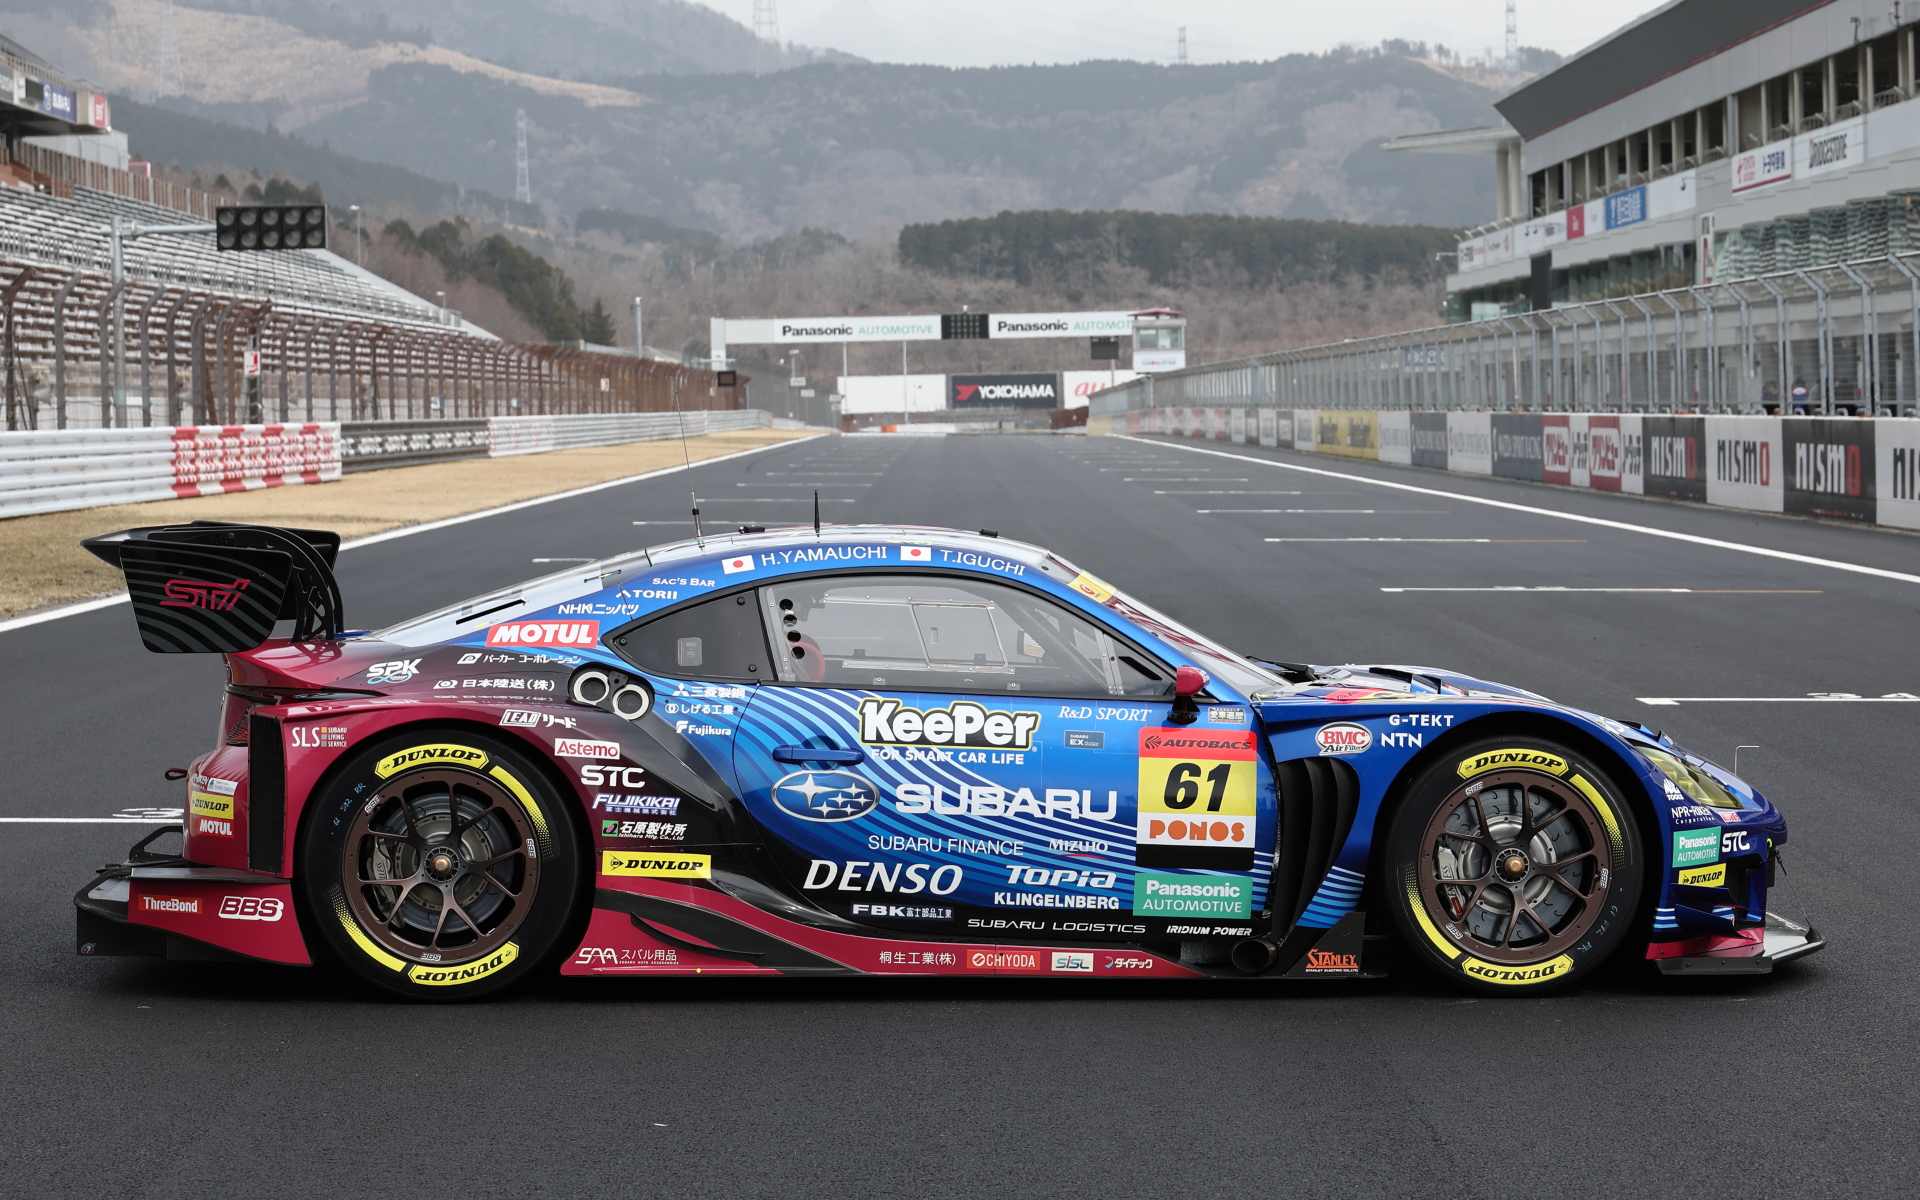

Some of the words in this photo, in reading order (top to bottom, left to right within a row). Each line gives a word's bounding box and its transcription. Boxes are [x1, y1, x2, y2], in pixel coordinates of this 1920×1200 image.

[1809, 134, 1847, 168] BRIDGESTONE
[782, 324, 852, 336] Panasonic
[858, 325, 933, 335] AUTOMOTIVE
[998, 320, 1068, 332] Panasonic
[1074, 320, 1132, 330] AUTOMOT
[978, 384, 1054, 399] YOKOHAMA
[1651, 436, 1696, 478] nismo
[1718, 440, 1770, 486] nismo
[1796, 442, 1860, 496] nismo
[1893, 448, 1920, 499] ni
[761, 546, 887, 566] H.YAMAUCHI
[940, 550, 1026, 576] T.IGUCHI
[632, 590, 678, 599] TORII
[492, 624, 593, 644] MOTUL
[366, 658, 422, 678] SPK
[680, 704, 734, 716] しげる工業
[1059, 706, 1092, 720] R&D
[1096, 708, 1152, 722] SPORT
[542, 714, 577, 728] リード
[862, 702, 1036, 746] KeePer
[1388, 714, 1454, 726] G-TEKT
[292, 727, 320, 748] SLS
[688, 725, 732, 736] Fujikura
[1323, 731, 1366, 746] BMC
[1162, 738, 1252, 750] AUTOBACS
[1381, 732, 1422, 748] NTN
[556, 740, 618, 758] Astemo
[871, 748, 900, 761] FOR
[905, 749, 956, 762] SMART
[958, 751, 986, 764] CAR
[992, 752, 1024, 765] LIFE
[1323, 744, 1343, 753] Air
[392, 748, 482, 768] DUNLOP
[1474, 752, 1562, 770] DUNLOP
[580, 764, 646, 788] STC
[1163, 762, 1232, 812] 61
[194, 798, 229, 811] DUNLOP
[592, 794, 680, 809] FUJIKIKAI
[895, 784, 1117, 820] SUBARU
[1671, 805, 1712, 818] NPR-RIKEN
[200, 819, 232, 836] MOTUL
[620, 821, 688, 836] 石原製作所
[1150, 820, 1244, 842] PONOS
[868, 835, 942, 853] SUBARU
[948, 838, 1024, 856] FINANCE
[1049, 838, 1108, 853] MIZUHO
[1679, 833, 1717, 849] Panasonic
[1722, 831, 1750, 852] STC
[1678, 848, 1717, 861] AUTOMOTIVE
[625, 859, 703, 871] DUNLOP
[802, 859, 963, 895] DENSO
[1690, 871, 1722, 884] DUNLOP
[1146, 880, 1240, 898] Panasonic
[144, 896, 198, 913] ThreeBond
[218, 896, 284, 921] BBS
[994, 892, 1119, 910] KLINGELNBERG
[1143, 899, 1242, 913] AUTOMOTIVE
[853, 904, 905, 917] FBK
[967, 919, 1045, 930] SUBARU
[1052, 922, 1146, 934] LOGISTICS
[1166, 925, 1210, 935] IRIDIUM
[1212, 926, 1252, 936] POWER
[621, 949, 677, 961] スバル用品
[879, 951, 956, 966] 桐生工業(株)
[986, 953, 1035, 968] CHIYODA
[1114, 957, 1153, 969] ダイテック
[1306, 949, 1359, 968] STANLEY
[415, 954, 503, 982] DUNLOP
[1468, 964, 1557, 981] DUNLOP
